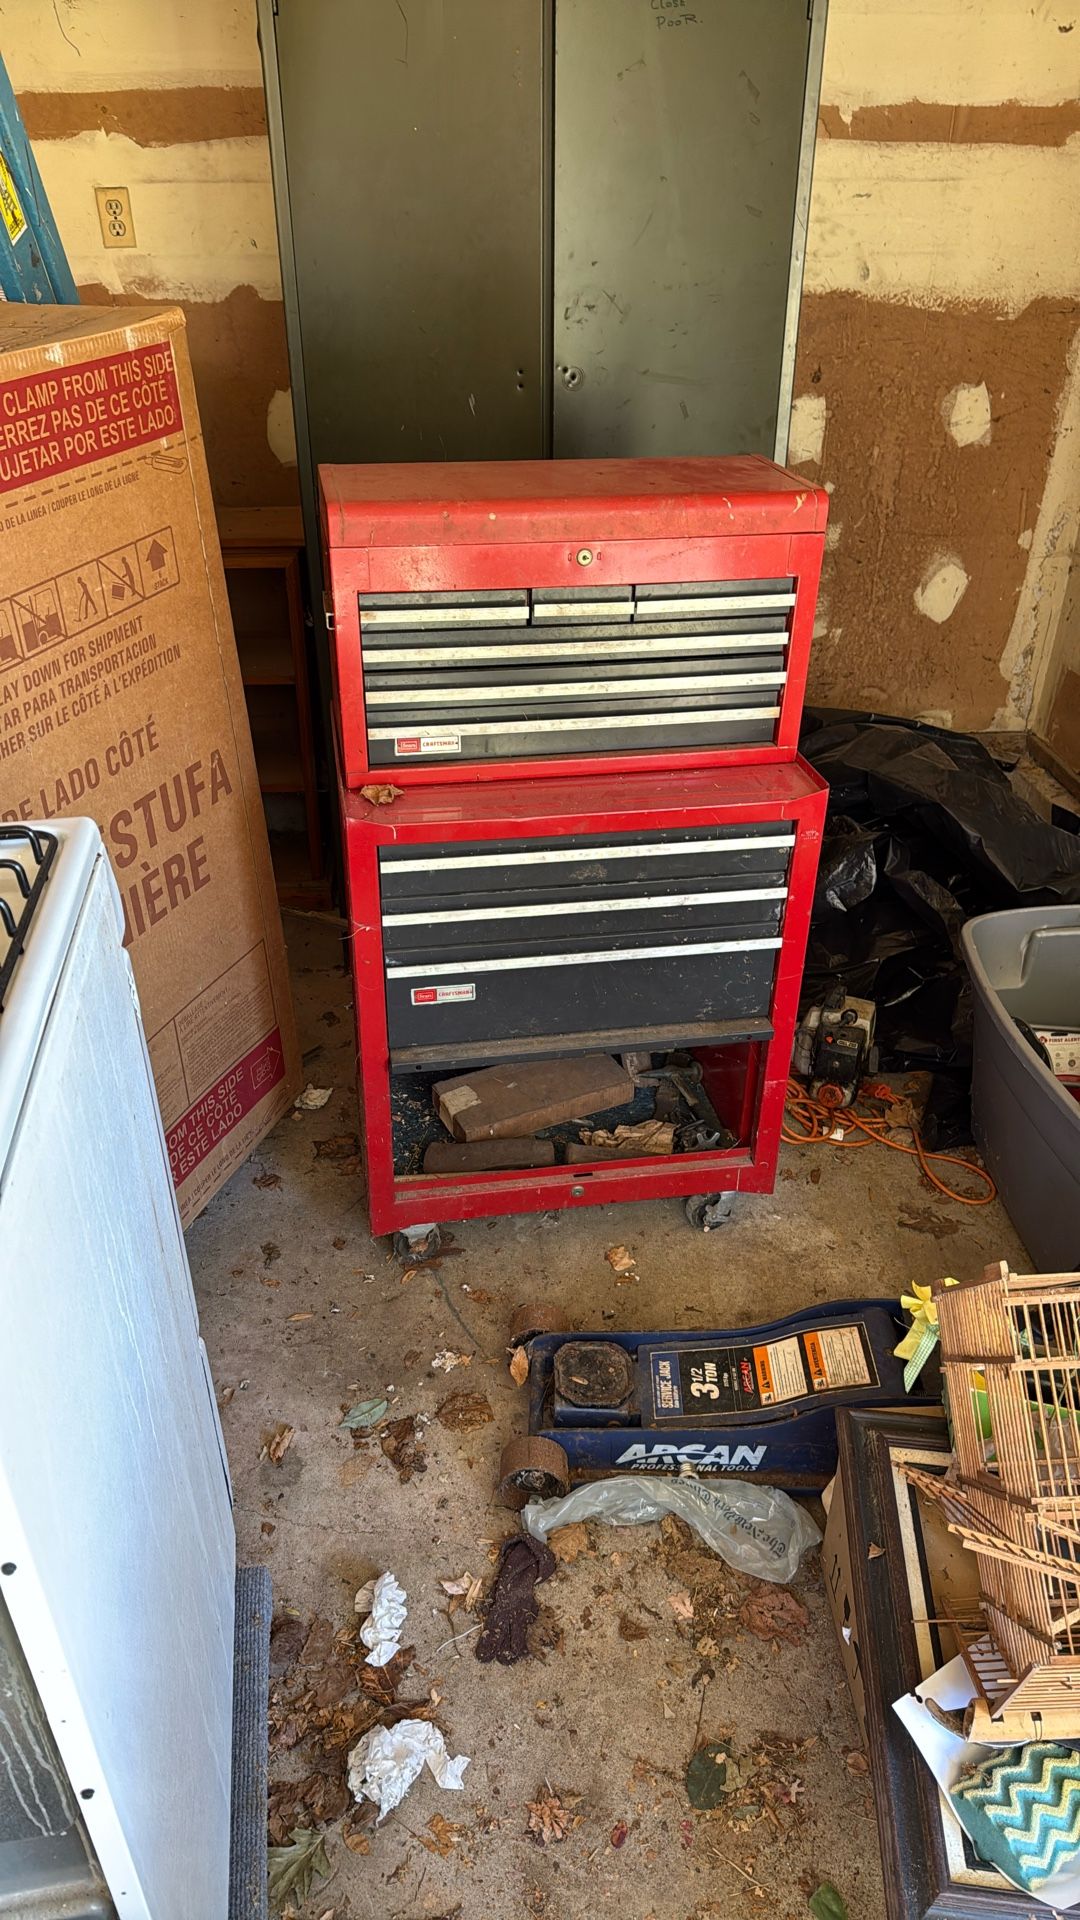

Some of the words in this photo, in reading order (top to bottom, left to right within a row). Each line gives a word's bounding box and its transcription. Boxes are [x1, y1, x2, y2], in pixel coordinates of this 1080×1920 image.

[3, 381, 59, 417] CLAMP
[61, 369, 108, 400] FROM
[109, 359, 142, 387] THIS
[143, 350, 174, 378] SIDE
[51, 404, 83, 434] PAS
[85, 398, 108, 423] DE
[109, 391, 131, 416] CE
[132, 375, 168, 409] CÔTÉ
[64, 430, 98, 460] POR
[99, 417, 137, 448] ESTE
[138, 405, 174, 435] LADO
[5, 516, 16, 530] DE
[16, 513, 26, 525] LA
[51, 494, 77, 511] COUPER
[78, 491, 86, 501] LE
[86, 484, 104, 498] LONG
[104, 482, 113, 492] DE
[113, 477, 122, 488] LA
[0, 680, 18, 706] AY
[23, 659, 61, 693] DOWN
[63, 646, 87, 671] FOR
[88, 616, 143, 658] SHIPMENT
[0, 707, 21, 734] AR
[23, 687, 57, 720] PARA
[58, 633, 157, 700] TRANSPORTACION
[0, 731, 26, 760] HER
[28, 715, 53, 742] SUR
[55, 706, 70, 727] LE
[72, 684, 101, 718] CÔTÉ
[103, 680, 111, 700] À
[113, 643, 181, 694] L'EXPÉDITION
[39, 758, 101, 819] LADO
[105, 714, 159, 777] CÔTÉ
[100, 748, 233, 869] STUFA
[167, 1122, 188, 1149] OM
[189, 1095, 215, 1126] THIS
[218, 1067, 244, 1099] SIDE
[170, 1142, 187, 1168] DE
[188, 1123, 204, 1147] CE
[181, 1136, 210, 1175] ESTE
[211, 1103, 242, 1141] LADO
[658, 1360, 671, 1379] JACK
[690, 1367, 704, 1382] 1/2
[690, 1382, 720, 1400] 3
[704, 1362, 718, 1383] TON
[660, 1380, 673, 1409] SERVICE
[615, 1443, 767, 1465] ARCAN
[631, 1463, 718, 1472] PROFESNAL
[720, 1464, 758, 1472] TOOLS
[670, 1478, 711, 1505] Times
[734, 1515, 765, 1539] New
[762, 1535, 786, 1559] The
